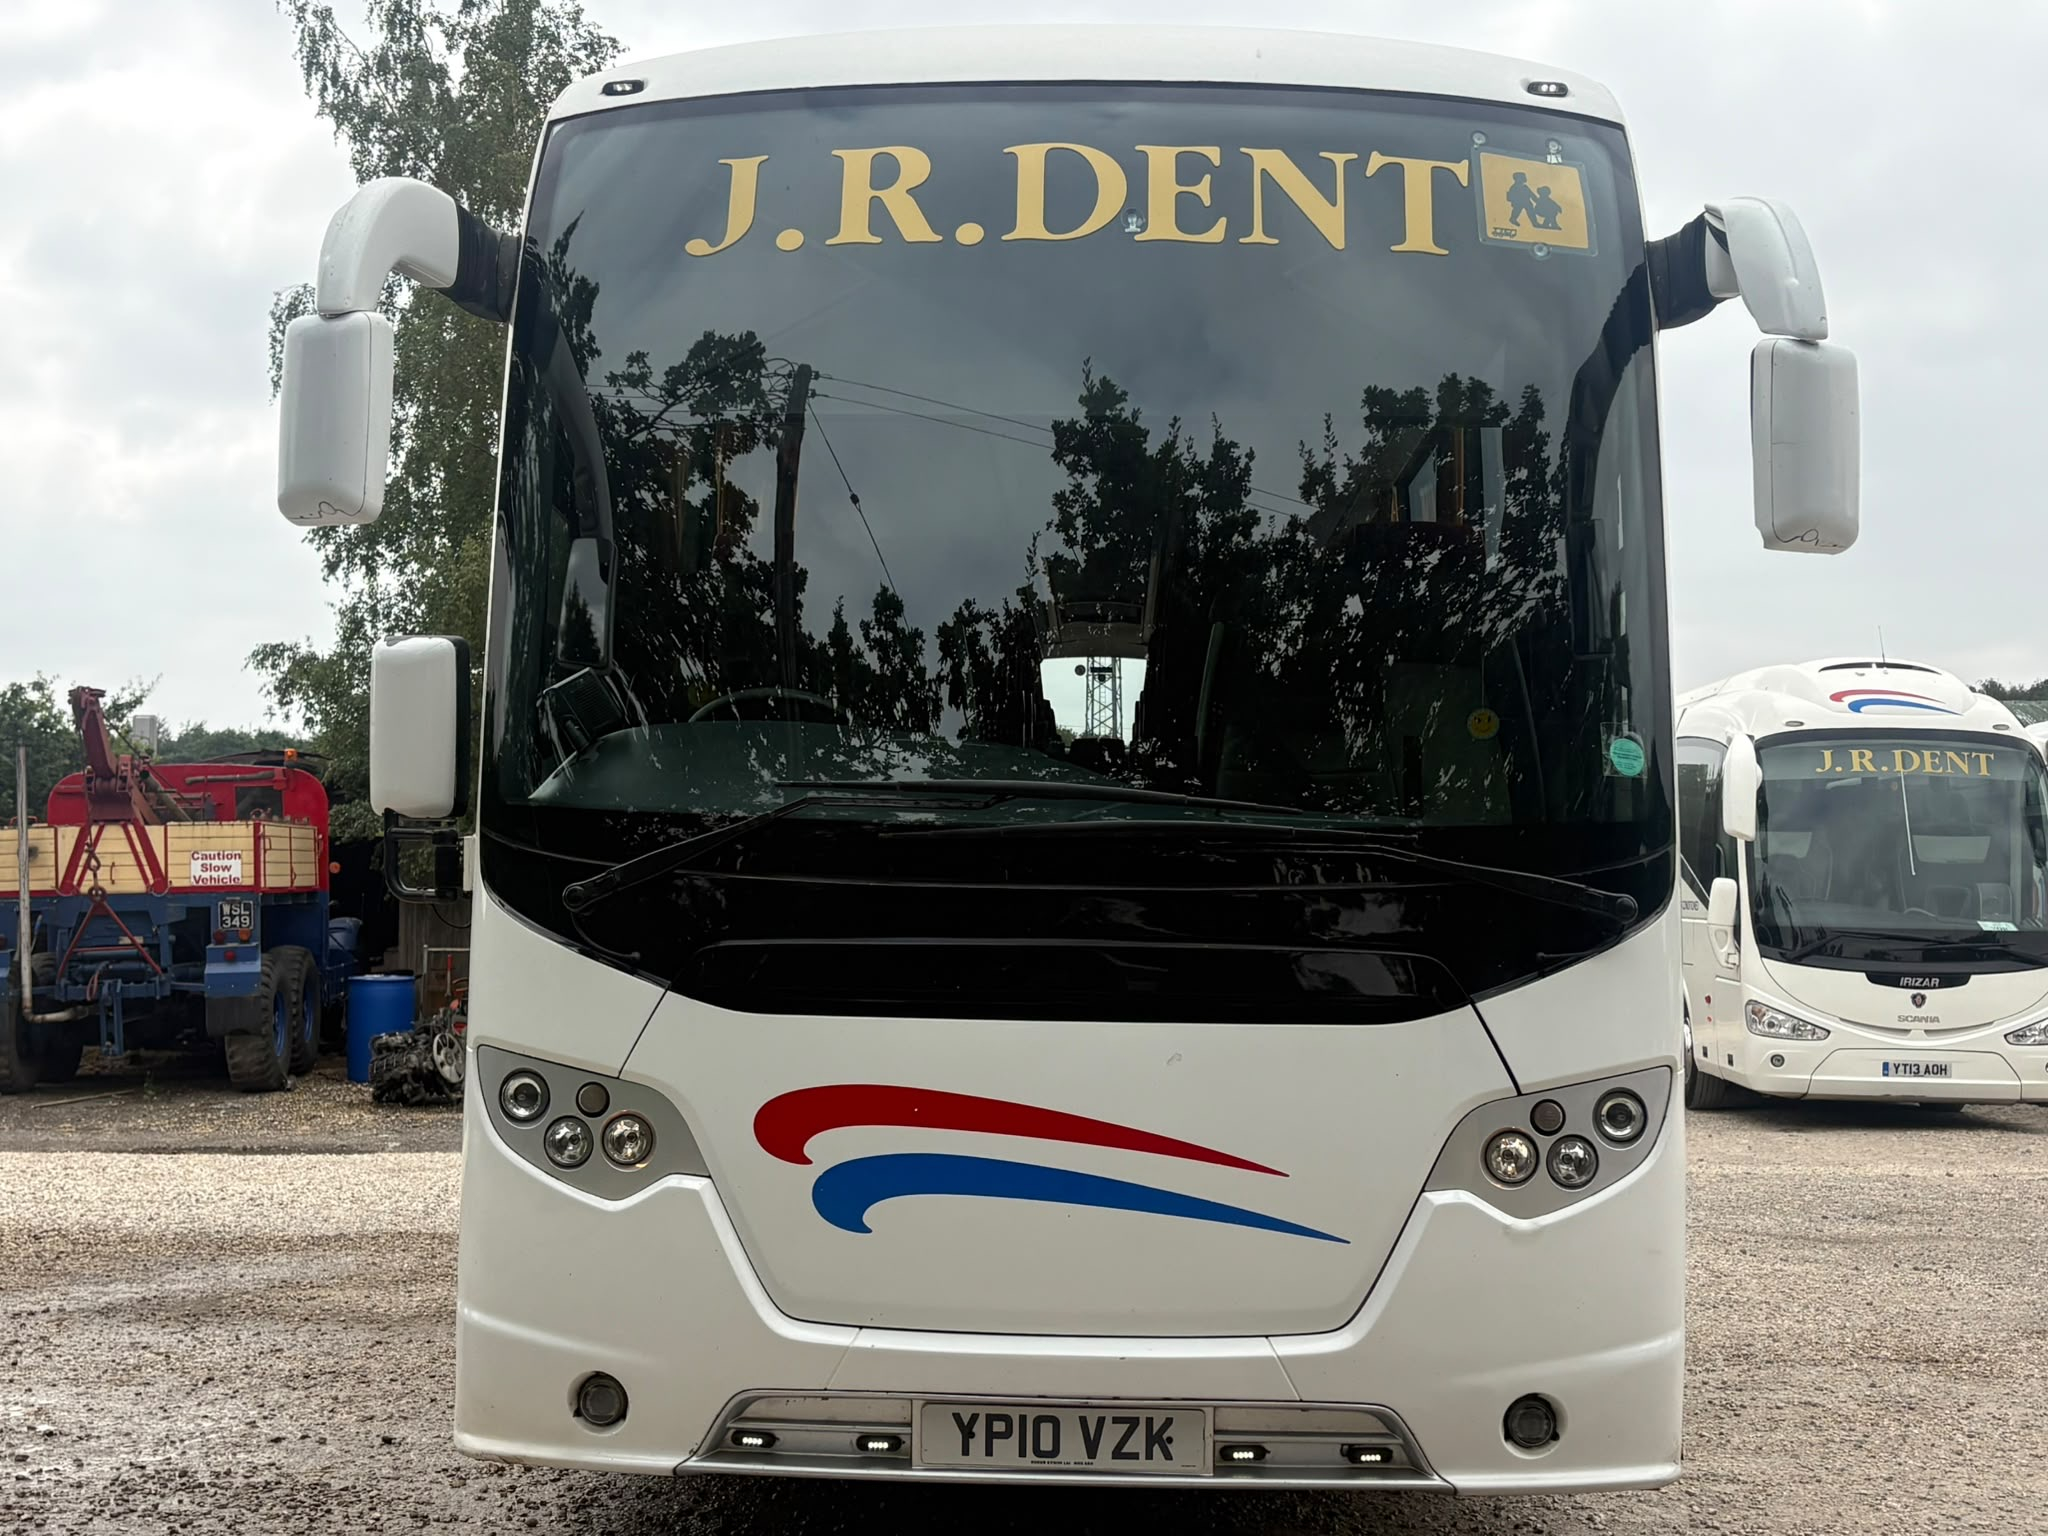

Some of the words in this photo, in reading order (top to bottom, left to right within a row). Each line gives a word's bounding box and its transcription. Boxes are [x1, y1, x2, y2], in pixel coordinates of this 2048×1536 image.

[191, 851, 241, 860] Caution
[200, 863, 232, 872] Slow
[193, 875, 240, 884] Vehicle
[222, 903, 250, 915] WSL
[222, 916, 250, 928] 349
[1900, 977, 1940, 987] IRIZAR
[1897, 1015, 1940, 1023] SCANIA
[1893, 1063, 1920, 1074] YT13
[1924, 1064, 1947, 1075] AOH
[951, 1412, 1061, 1459] YP10
[1078, 1415, 1174, 1461] VZK
